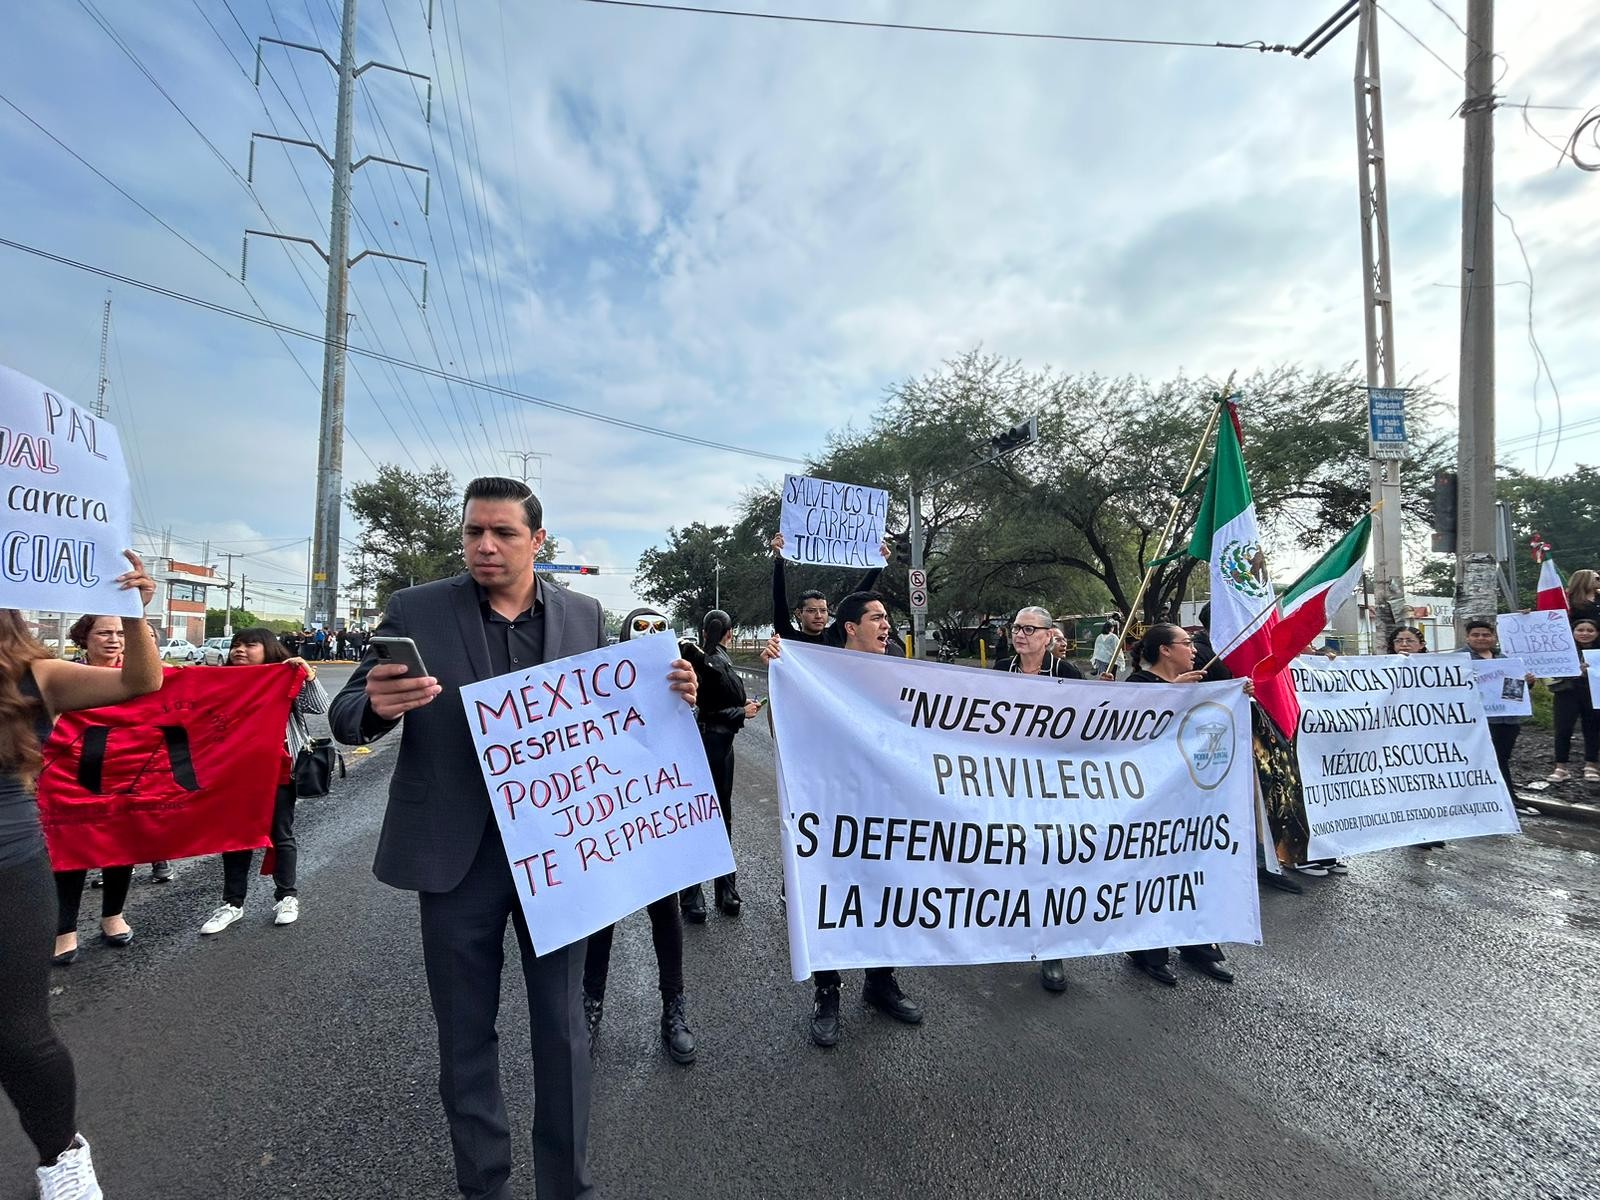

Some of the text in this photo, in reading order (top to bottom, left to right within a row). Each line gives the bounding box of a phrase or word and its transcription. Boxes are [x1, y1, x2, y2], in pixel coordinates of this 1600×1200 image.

[8, 484, 108, 523] carrera
[786, 476, 886, 518] SALVEMOS LA
[806, 508, 878, 543] CARRERA
[2, 530, 99, 588] CIAL
[792, 534, 875, 566] JUDICIAL
[1508, 634, 1571, 653] LIBRES
[474, 659, 636, 735] MÉXICO
[1289, 668, 1388, 693] PENDENCIA
[1381, 665, 1474, 695] JUDICIAL,
[900, 687, 1174, 741] "NUESTRO ÚNICO
[1301, 701, 1477, 734] GARANTÍA NACIONAL.
[483, 706, 645, 776] DESPIERTA
[1321, 742, 1469, 777] MÉXICO, ESCUCHA,
[497, 755, 621, 820] PODER
[933, 753, 1145, 800] PRIVILEGIO
[1305, 769, 1497, 807] TU JUSTICIA ES NUESTRA LUCHA.
[552, 763, 692, 837] JUDICIAL
[1311, 801, 1503, 837] SOMOS PODER JUDICIAL DEL ESTADO DE GUANAJUATO.
[514, 793, 721, 896] TE REPRESENTA
[791, 812, 1239, 865] S DEFENDER TUS DERECHOS,
[818, 871, 1204, 930] LA JUSTICIA NO SE VOTA"
